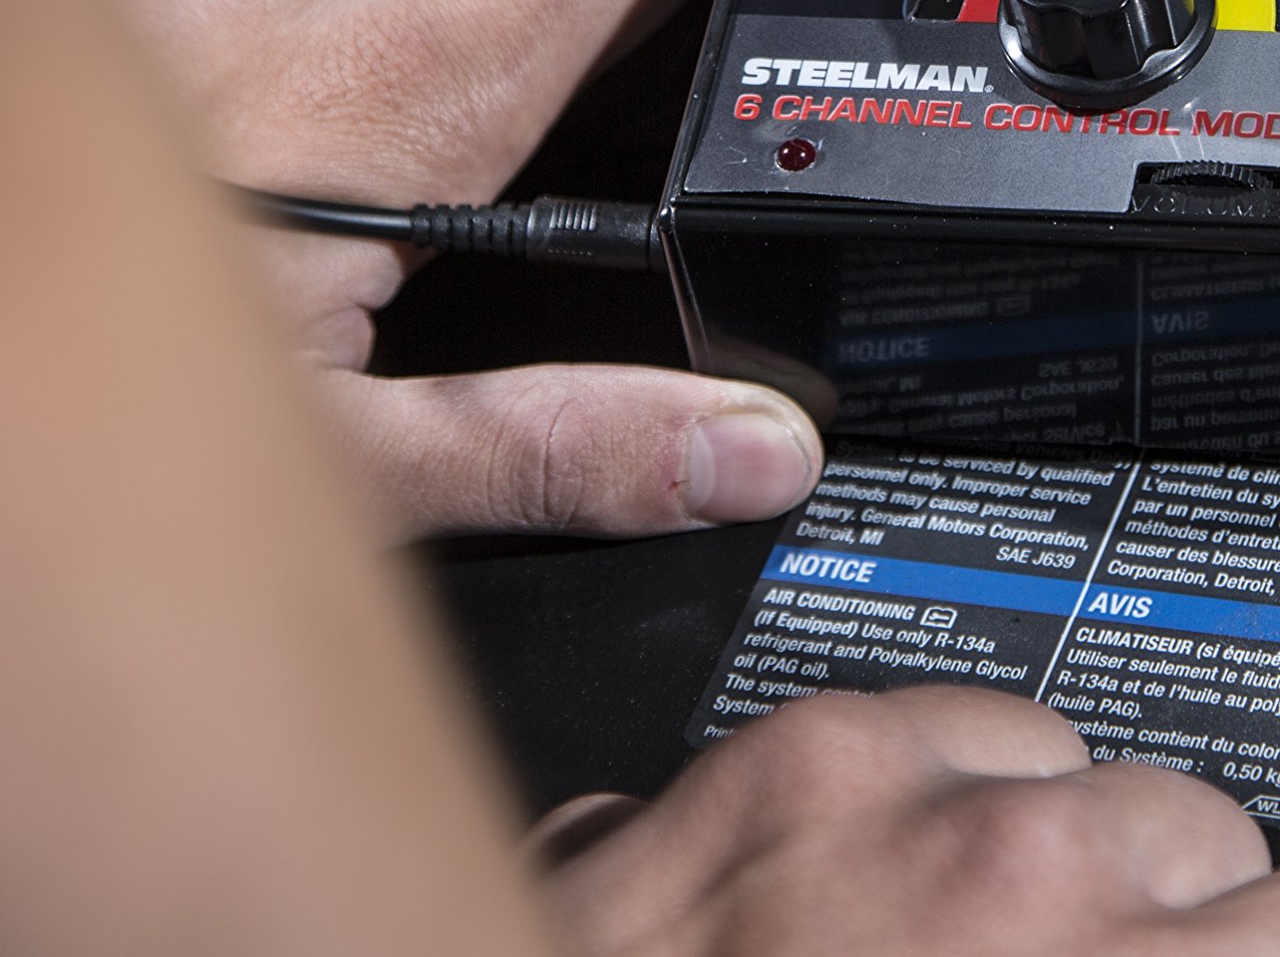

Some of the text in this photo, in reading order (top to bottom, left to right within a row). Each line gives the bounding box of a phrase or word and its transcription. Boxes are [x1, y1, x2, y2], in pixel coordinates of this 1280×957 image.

[734, 94, 763, 120] 6
[772, 95, 972, 129] CHANNEL
[983, 103, 1180, 137] CONTROL
[823, 460, 907, 483] personnel
[951, 475, 1028, 500] Improper
[1030, 486, 1092, 506] service
[943, 454, 1014, 475] serviced
[1016, 457, 1037, 478] by
[1040, 463, 1115, 487] qualified
[1228, 464, 1249, 482] de
[815, 481, 1056, 524] methods may cause personal
[1236, 485, 1260, 504] du
[1132, 499, 1164, 517] par
[1167, 502, 1188, 518] un
[1190, 505, 1276, 530] personnel
[860, 528, 884, 545] MI
[861, 508, 926, 530] General
[928, 516, 988, 537] Motors
[988, 523, 1091, 552] Corporation,
[1124, 518, 1209, 542] méthodes
[996, 547, 1076, 570] SAE J639
[1116, 541, 1177, 560] causer
[1178, 544, 1209, 563] des
[779, 551, 877, 584] NOTICE
[1107, 560, 1208, 588] Corporation,
[763, 588, 916, 621] AIR CONDITIONING
[1087, 590, 1153, 619] AVIS
[775, 613, 859, 639] Equipped)
[861, 624, 893, 641] Use
[896, 629, 932, 648] only
[934, 633, 996, 655] R-134a
[1076, 627, 1194, 656] CLIMATISEUR
[1196, 640, 1220, 660] (si
[734, 653, 755, 669] oil
[756, 656, 799, 678] (PAG
[743, 632, 1028, 682] refrigerant and Polyalkylene Glycol
[1067, 648, 1128, 671] Utiliser
[1128, 656, 1219, 683] seulement
[1220, 667, 1238, 684] le
[725, 674, 756, 692] The
[757, 680, 818, 698] system
[1057, 670, 1119, 693] R-134a
[1122, 680, 1141, 695] et
[1143, 681, 1166, 698] de
[1225, 693, 1247, 709] au
[713, 695, 776, 716] System
[1047, 692, 1096, 712] (huile
[704, 724, 738, 740] Print
[1138, 727, 1207, 750] contient
[1211, 734, 1234, 753] du
[1093, 744, 1116, 762] du
